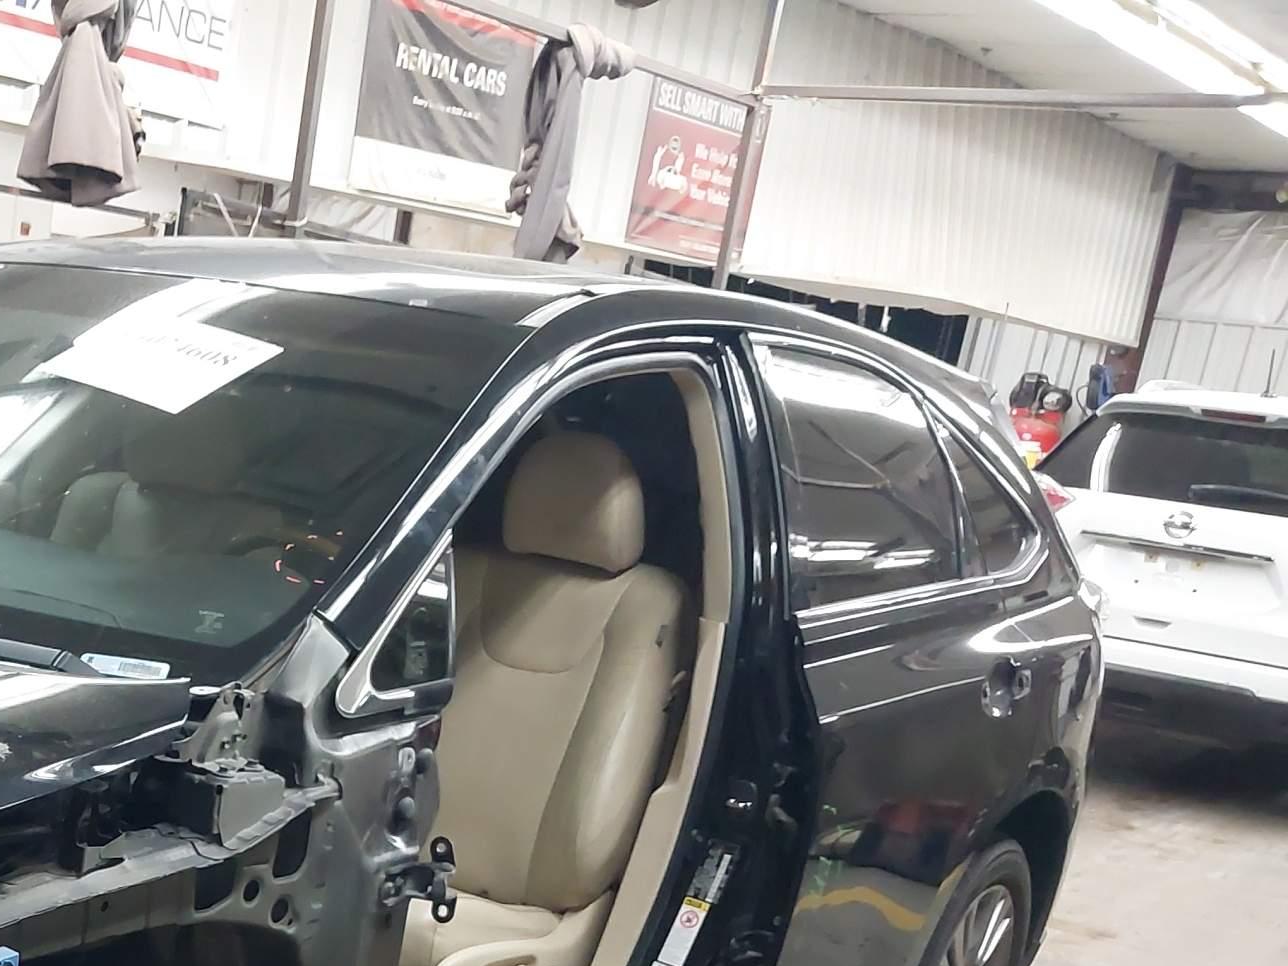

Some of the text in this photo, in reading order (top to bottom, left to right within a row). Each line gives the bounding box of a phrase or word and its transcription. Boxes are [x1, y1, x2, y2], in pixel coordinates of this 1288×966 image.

[395, 41, 508, 97] RENTAL CARS
[658, 82, 747, 133] SELL SMART WITH
